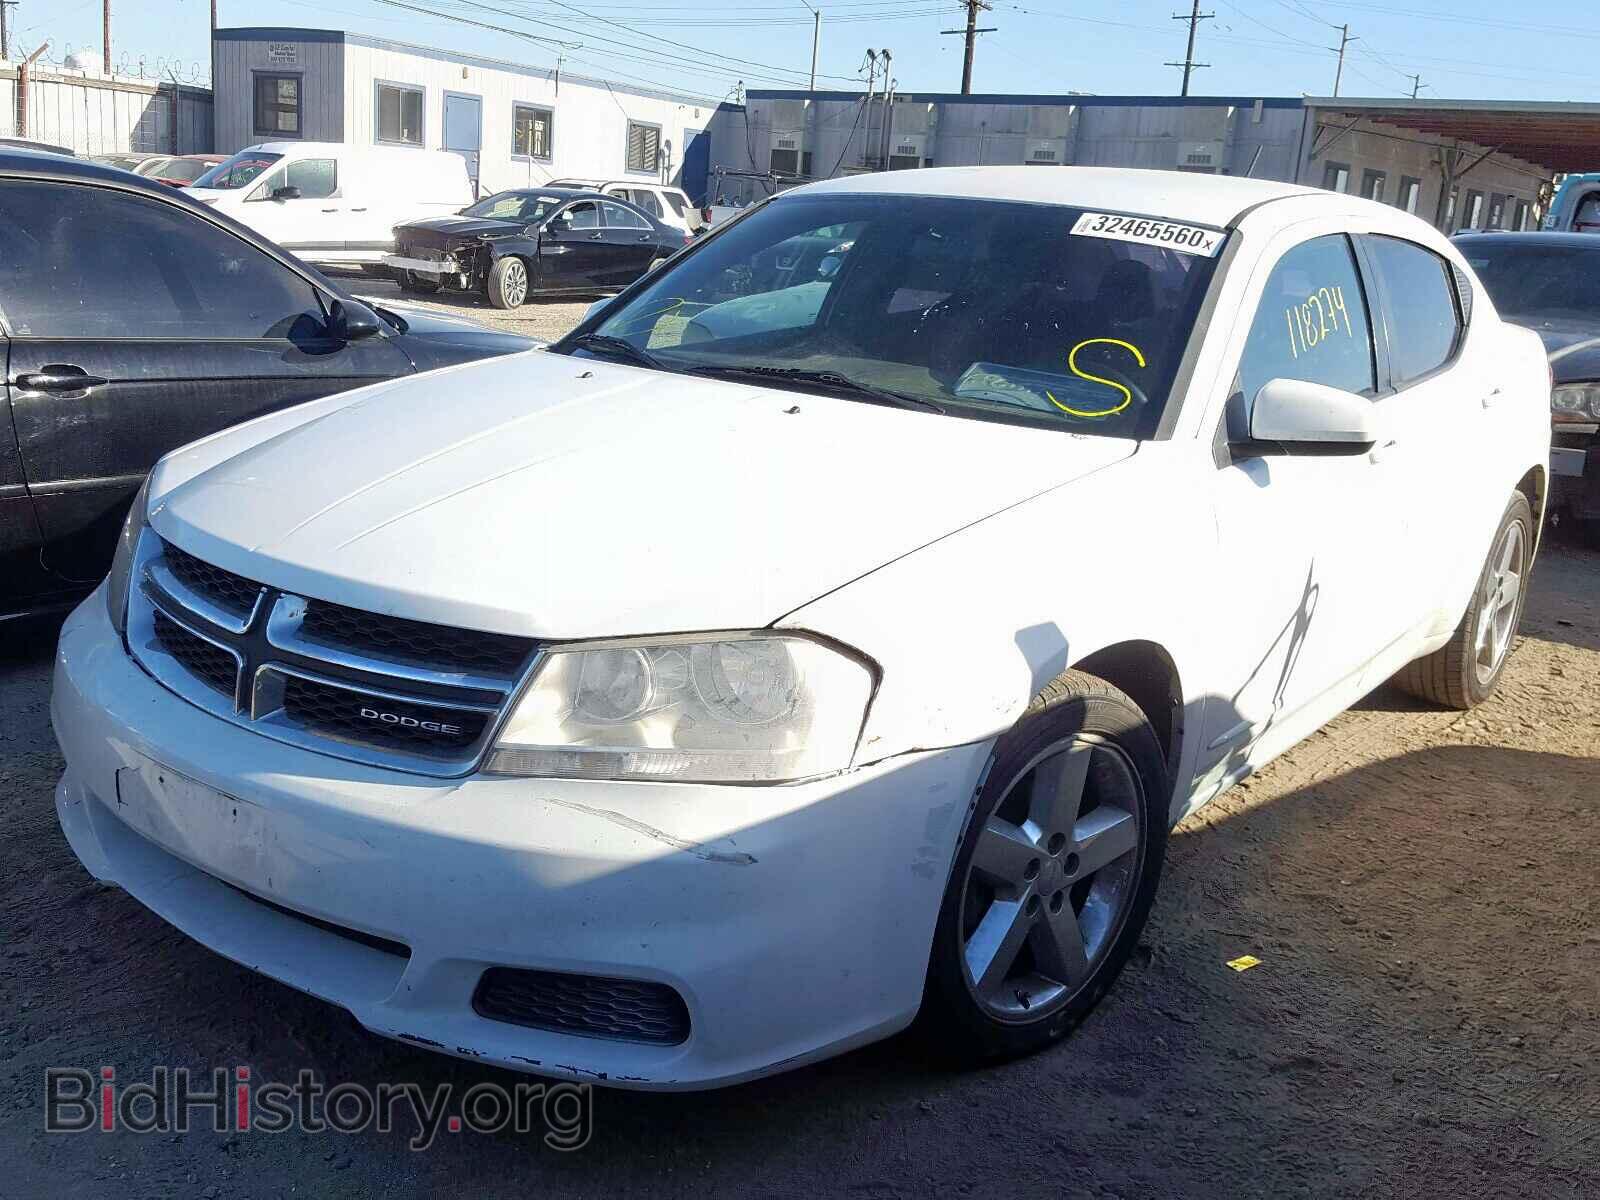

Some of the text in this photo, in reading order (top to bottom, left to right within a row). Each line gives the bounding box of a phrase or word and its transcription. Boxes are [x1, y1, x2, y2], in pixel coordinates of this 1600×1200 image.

[1092, 215, 1205, 247] 32465560
[1046, 338, 1146, 417] S
[360, 708, 461, 735] DODGE
